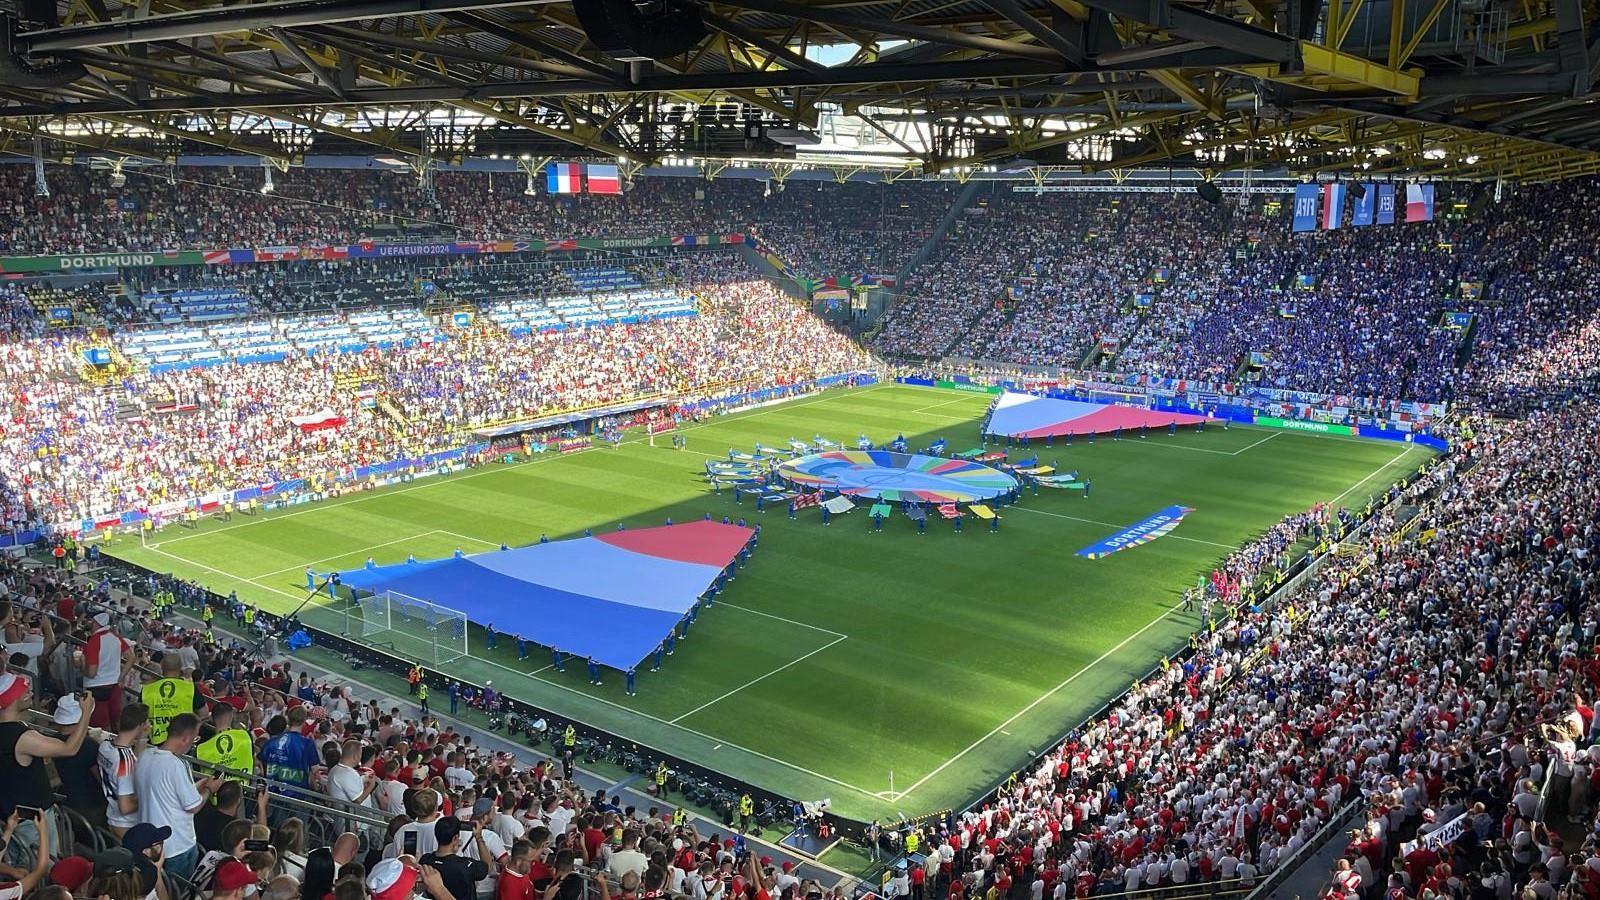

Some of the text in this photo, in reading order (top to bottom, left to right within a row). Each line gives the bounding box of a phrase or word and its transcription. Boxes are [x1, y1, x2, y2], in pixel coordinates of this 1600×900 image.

[603, 239, 648, 247] DORTMUND
[60, 254, 154, 269] DORTMUND
[1282, 420, 1329, 432] DORTMUND
[1105, 515, 1171, 547] DORTMUND
